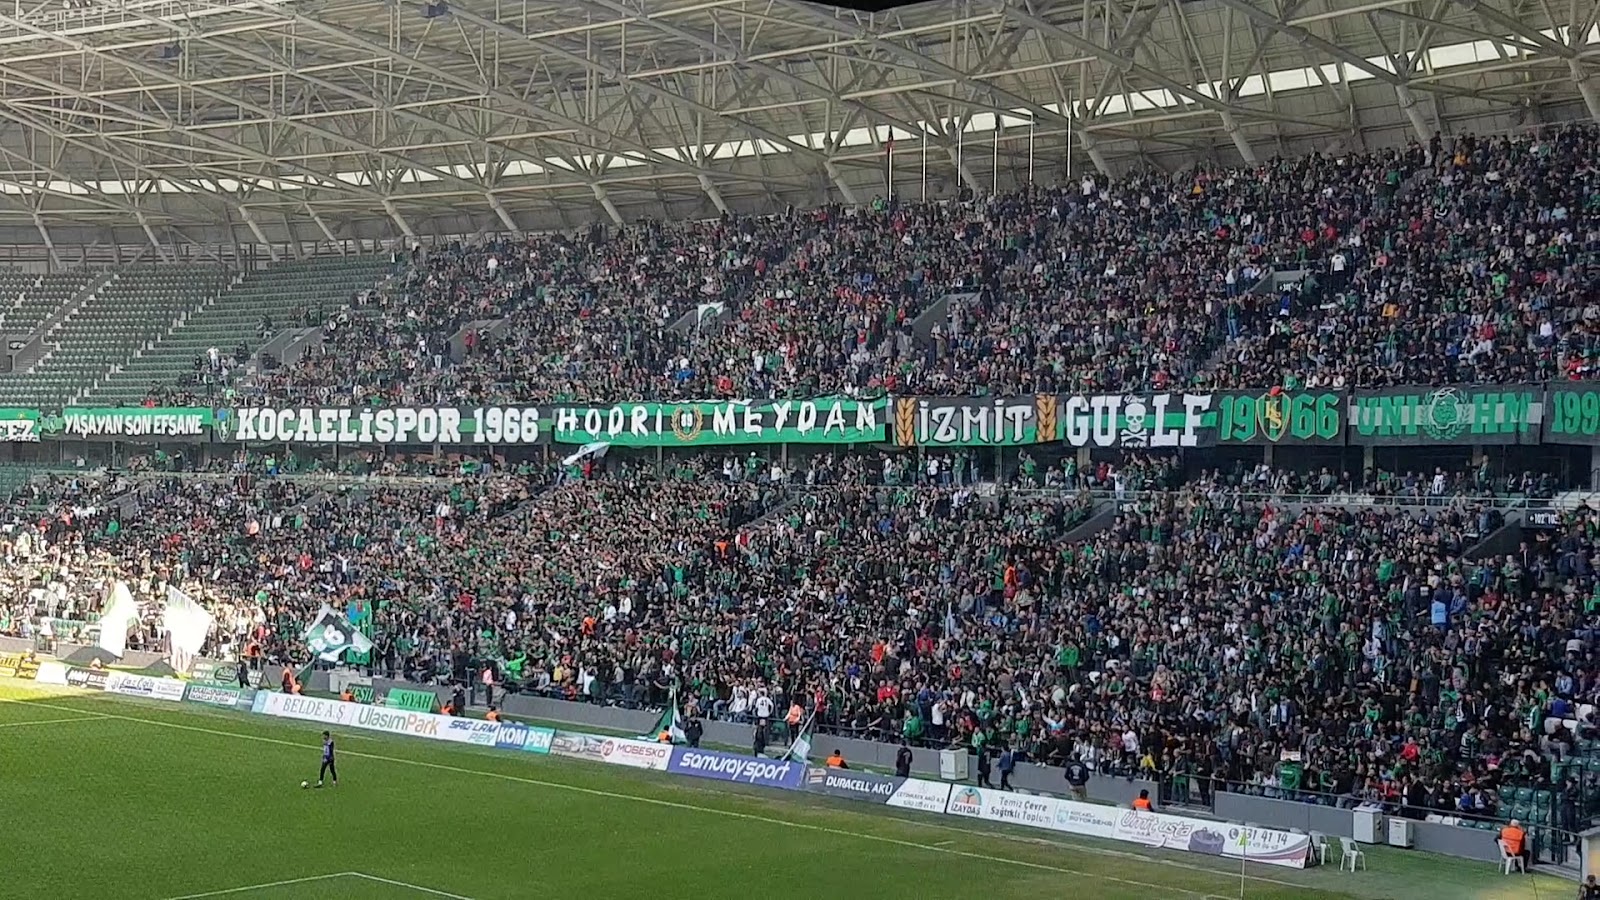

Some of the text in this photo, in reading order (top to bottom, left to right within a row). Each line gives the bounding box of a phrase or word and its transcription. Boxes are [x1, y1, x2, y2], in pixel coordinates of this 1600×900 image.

[64, 414, 203, 438] YAŞAYAN SON EFSANE
[236, 407, 539, 443] KOCAELİSPOR 1966
[713, 401, 877, 438] MEYDAN
[919, 400, 1033, 443] İZMİT
[283, 699, 323, 716] BELDE
[617, 744, 666, 758] MOBESKO
[826, 776, 893, 795] DURACELL AKÜ
[1024, 800, 1048, 812] Çevre
